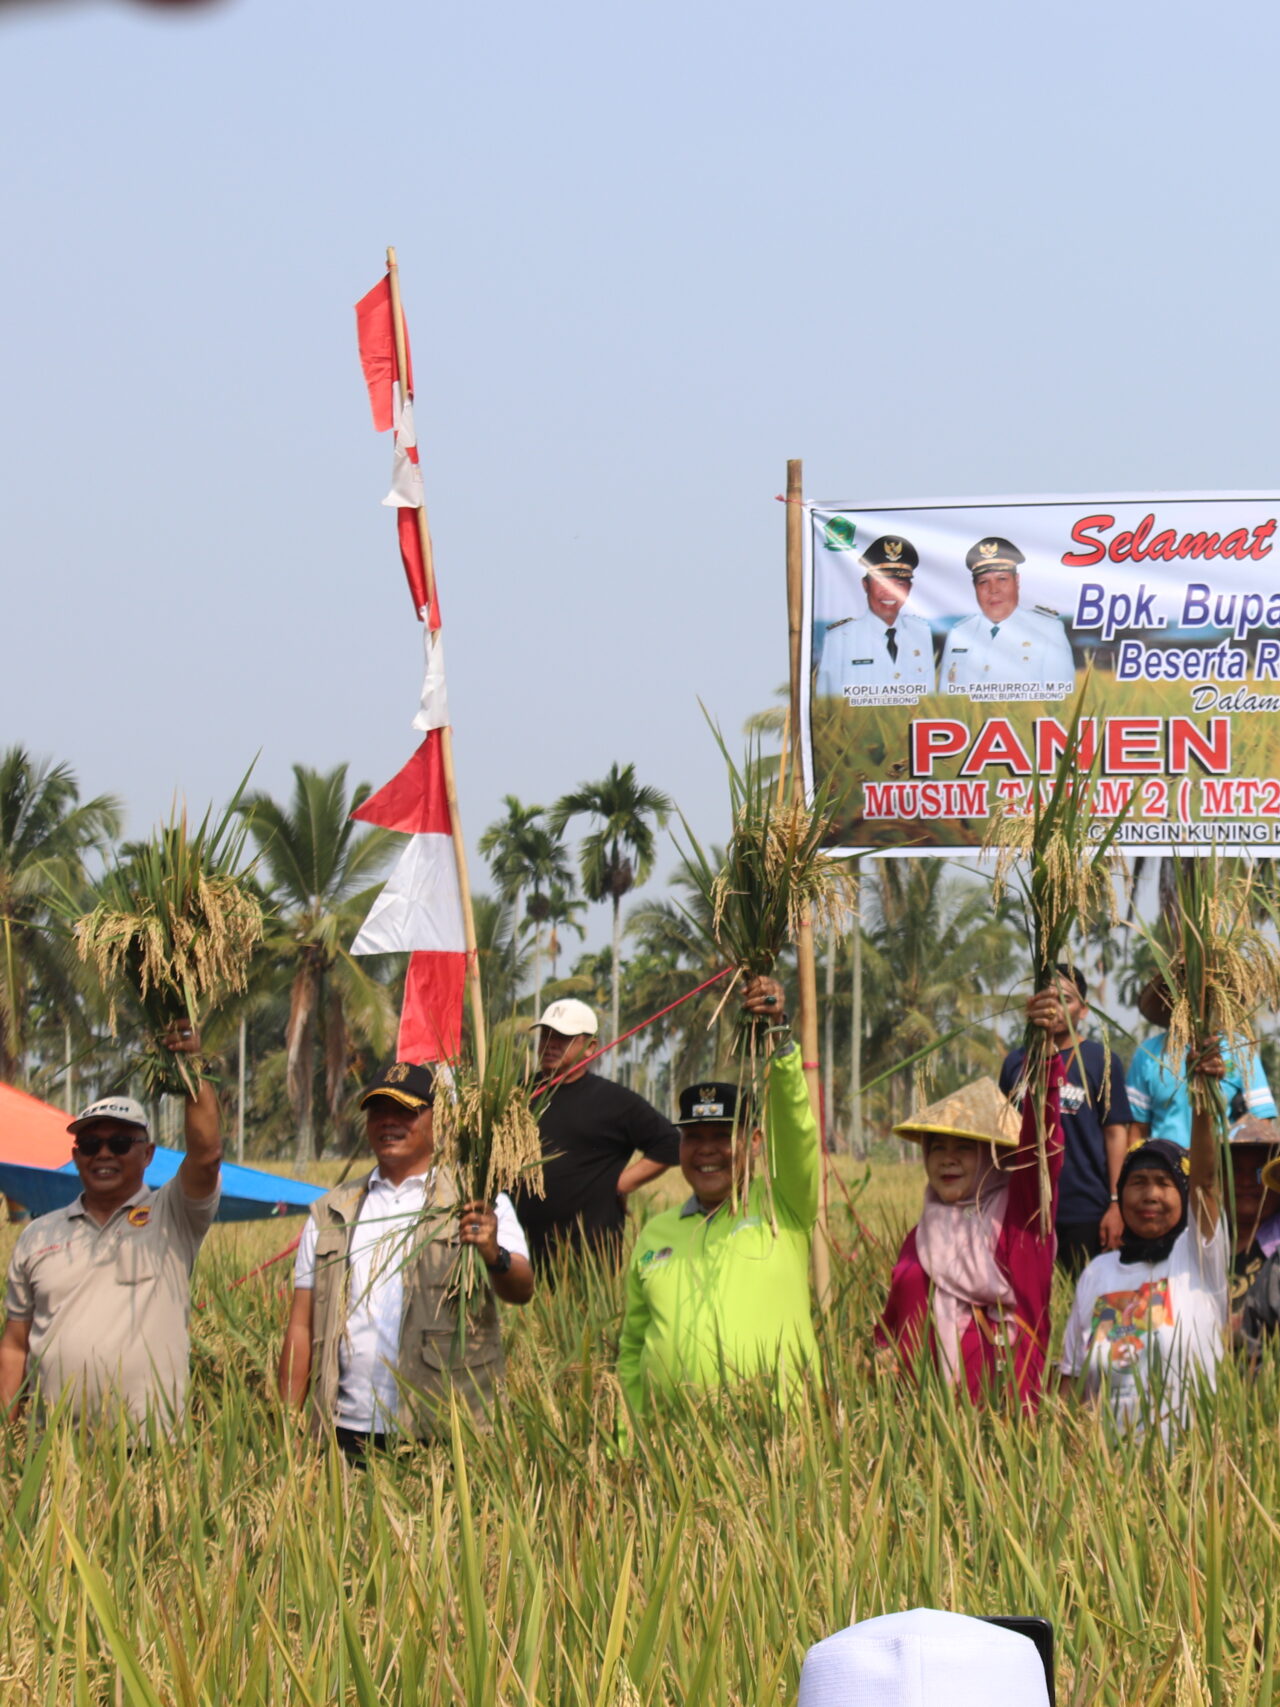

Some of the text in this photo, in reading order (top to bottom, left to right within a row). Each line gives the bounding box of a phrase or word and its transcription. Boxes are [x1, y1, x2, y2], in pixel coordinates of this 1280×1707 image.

[1061, 513, 1278, 567] Selamat
[1074, 582, 1167, 639] Bpk.
[1118, 642, 1246, 680] Beserta
[843, 684, 927, 696] KOPLI ANSORI
[850, 697, 918, 706] BUPATI LEBONG
[999, 693, 1027, 701] BUPATI
[1192, 685, 1280, 712] Dalam
[912, 717, 1231, 776] PANEN
[864, 781, 989, 819] MUSIM
[1188, 824, 1268, 841] KUNING
